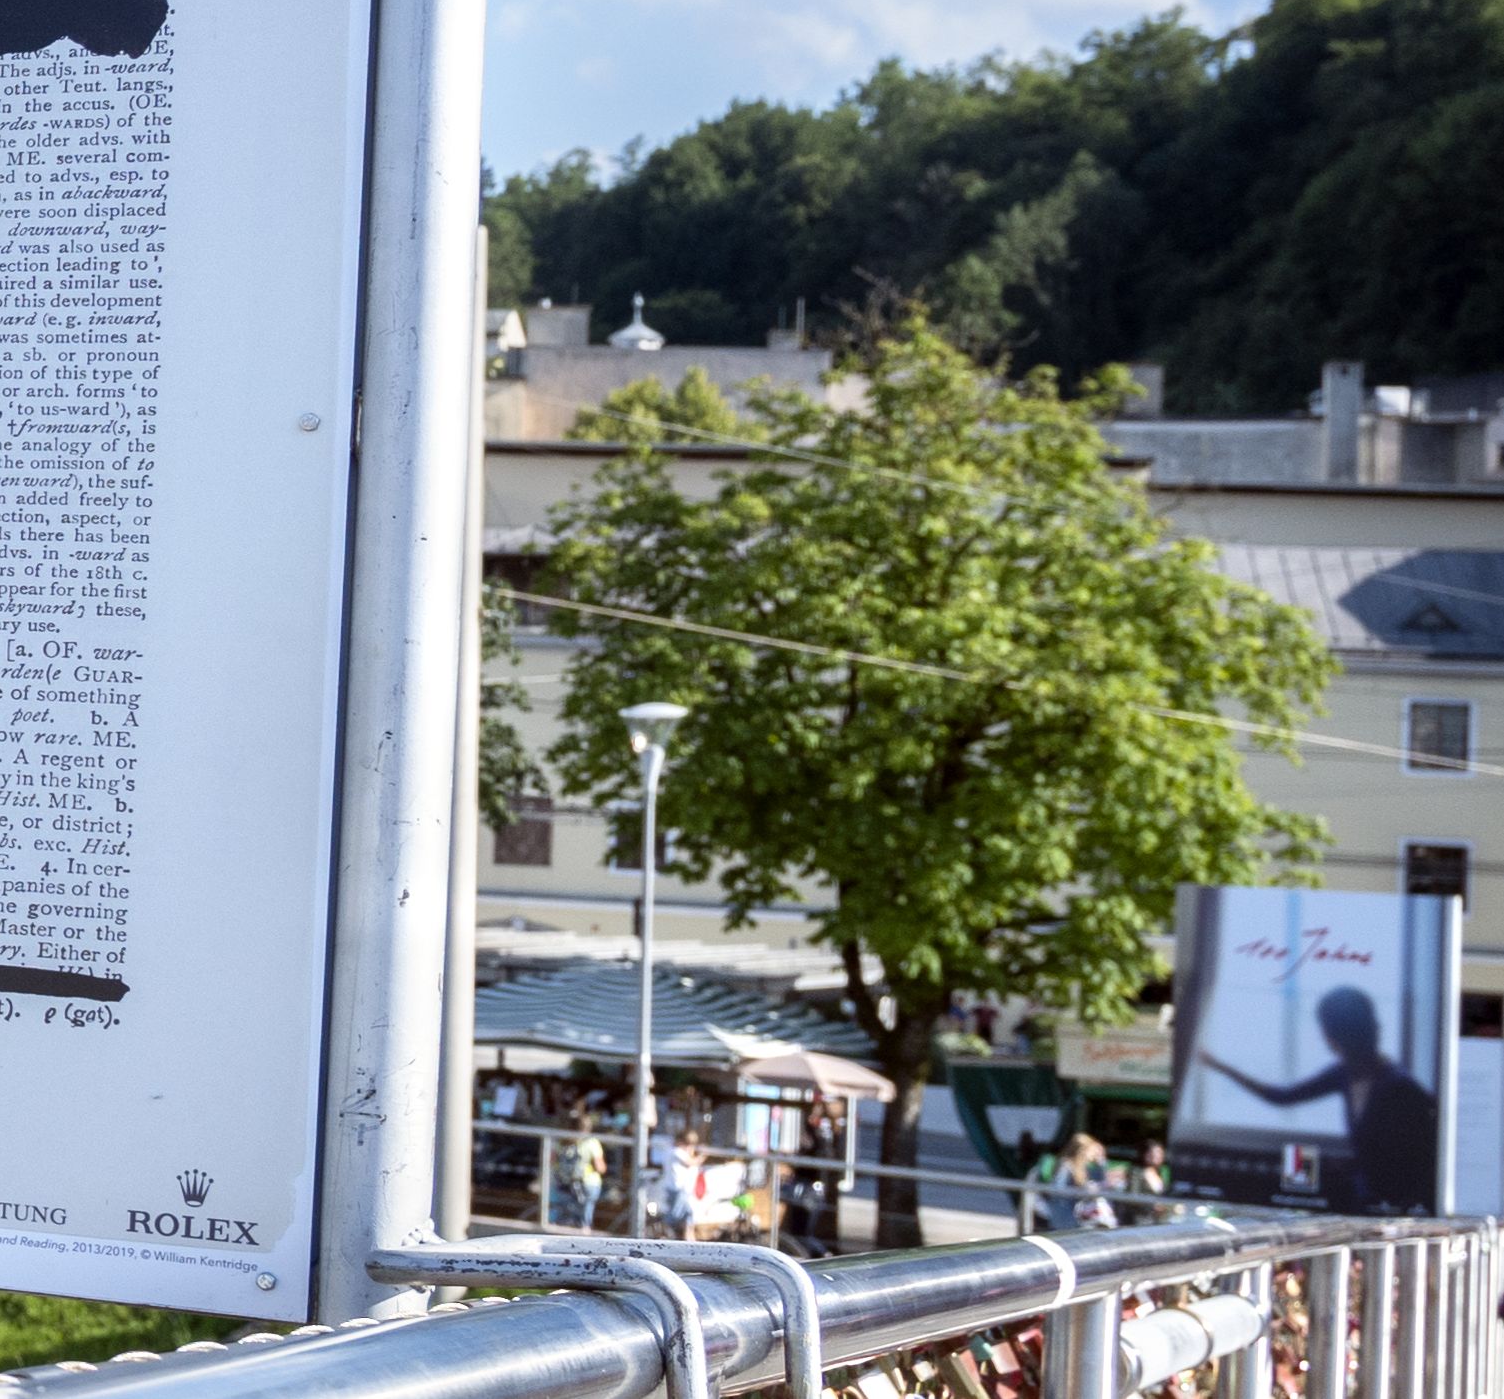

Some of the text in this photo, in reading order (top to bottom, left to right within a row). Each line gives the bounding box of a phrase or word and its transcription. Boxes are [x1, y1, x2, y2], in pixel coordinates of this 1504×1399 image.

[12, 291, 46, 308] this
[49, 291, 163, 311] development
[26, 620, 61, 634] use.
[32, 731, 82, 747] rare.
[91, 729, 136, 749] ME.
[61, 925, 85, 940] or
[94, 924, 128, 943] the
[126, 1210, 260, 1246] ROLEX
[20, 1236, 69, 1253] Reading,
[72, 1241, 137, 1260] 2013/2019,
[154, 1251, 196, 1265] William
[200, 1256, 259, 1273] Kentridge
